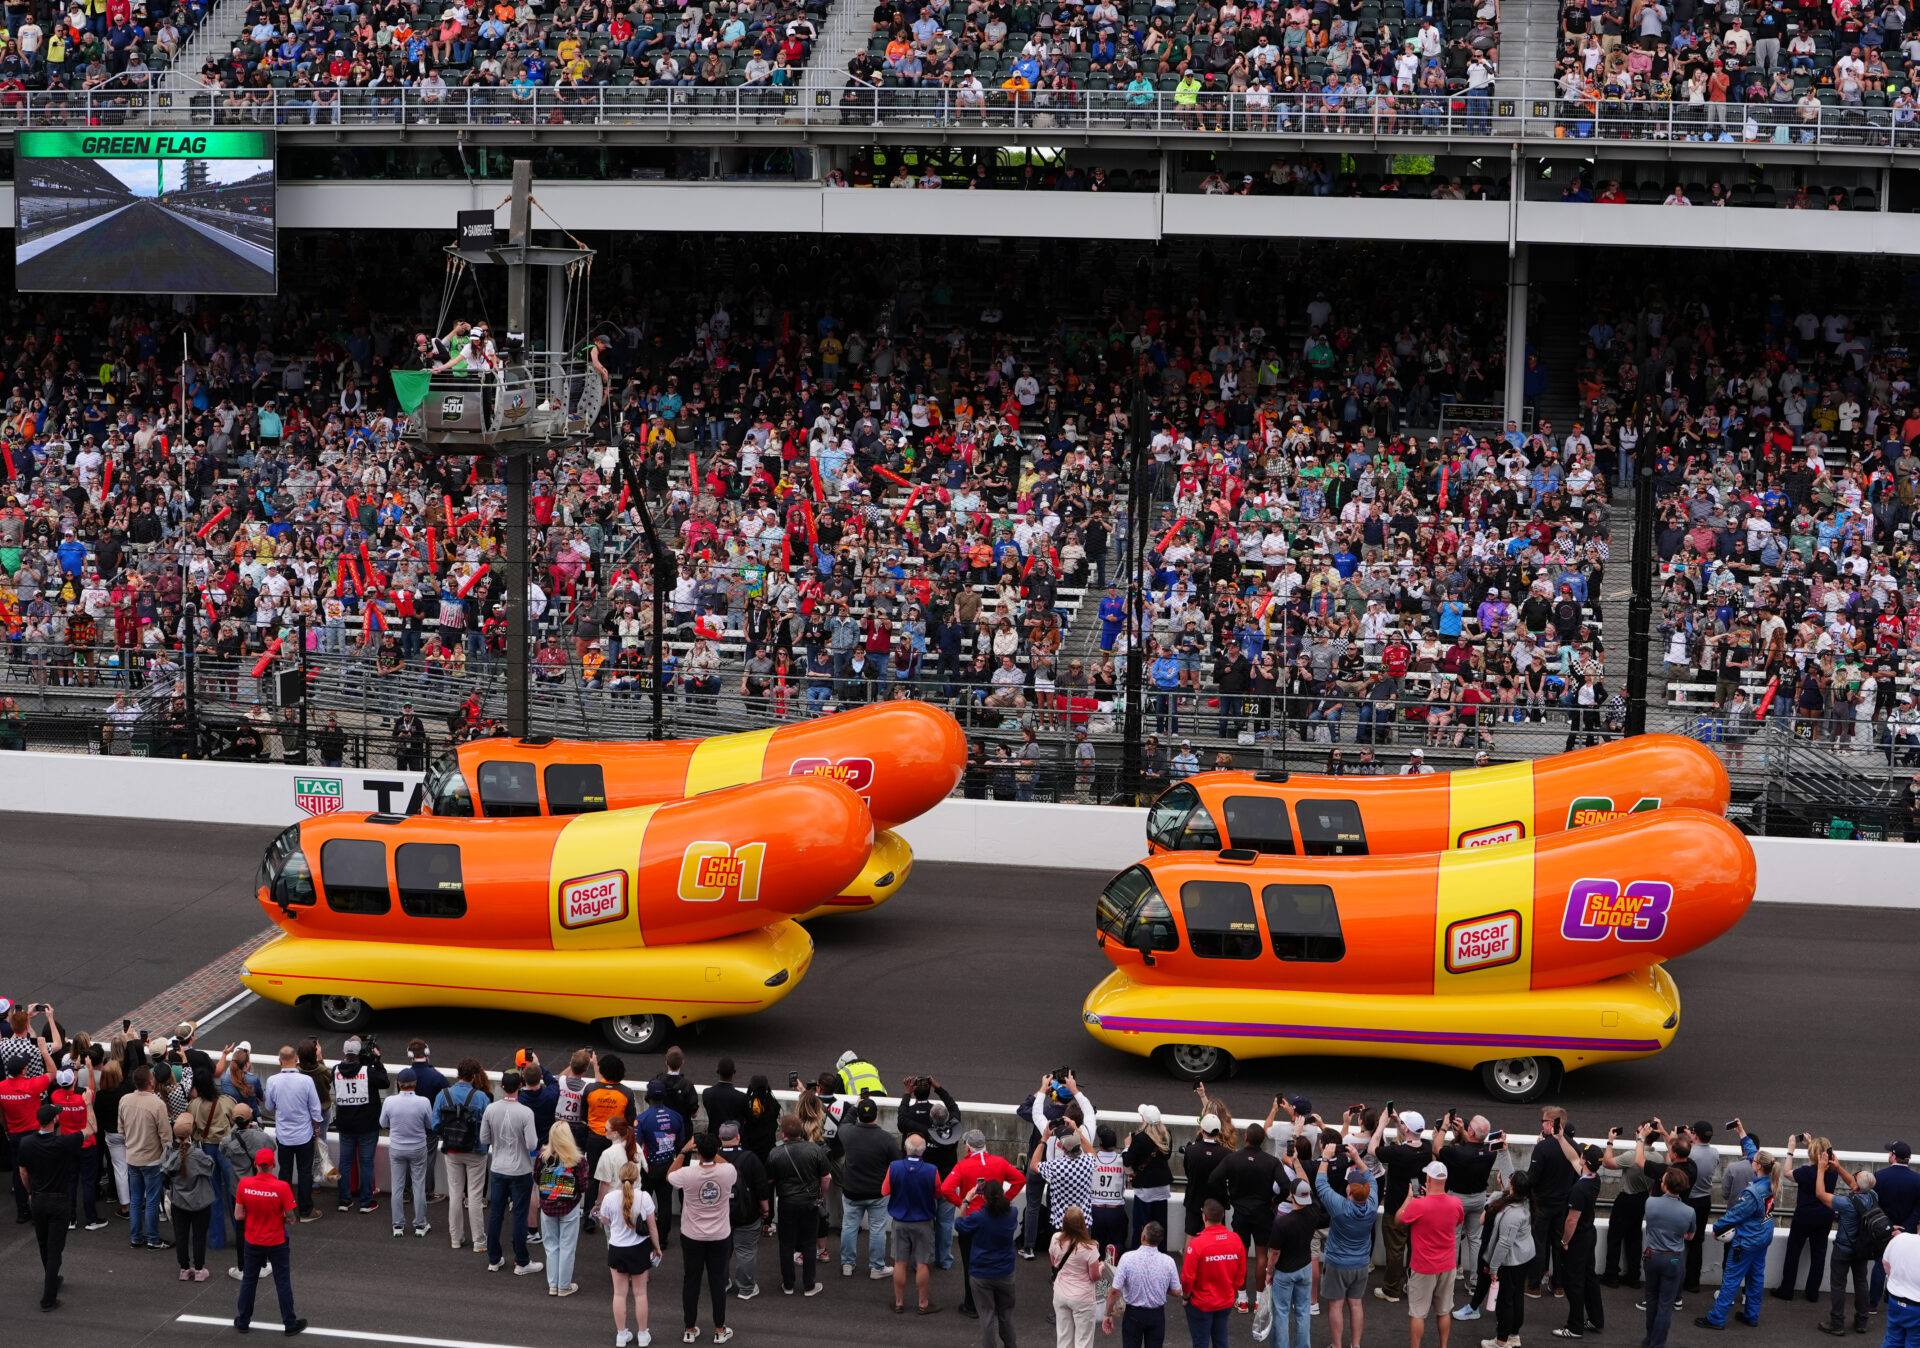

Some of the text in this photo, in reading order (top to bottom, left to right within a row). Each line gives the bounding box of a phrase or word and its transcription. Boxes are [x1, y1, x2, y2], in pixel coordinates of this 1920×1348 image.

[82, 136, 207, 154] GREEN FLAG
[442, 403, 464, 413] 500
[1249, 703, 1259, 714] 23
[1484, 713, 1494, 724] 24
[814, 765, 848, 779] NEW
[299, 780, 338, 794] TAG
[299, 796, 340, 816] HEUER
[708, 858, 738, 872] CHI
[704, 872, 739, 887] DOG
[571, 882, 615, 904] Oscar
[570, 896, 617, 918] Mayer
[1590, 895, 1644, 912] SLAW
[1595, 911, 1634, 927] DOG
[1460, 924, 1508, 946] Oscar
[1458, 938, 1509, 960] Mayer
[346, 1082, 357, 1094] 15
[336, 1096, 367, 1104] PHOTO
[564, 1100, 578, 1113] 28
[1095, 1165, 1122, 1174] anon
[1099, 1174, 1113, 1188] 97
[244, 1187, 278, 1198] HONDA
[1205, 1253, 1238, 1262] HONDA
